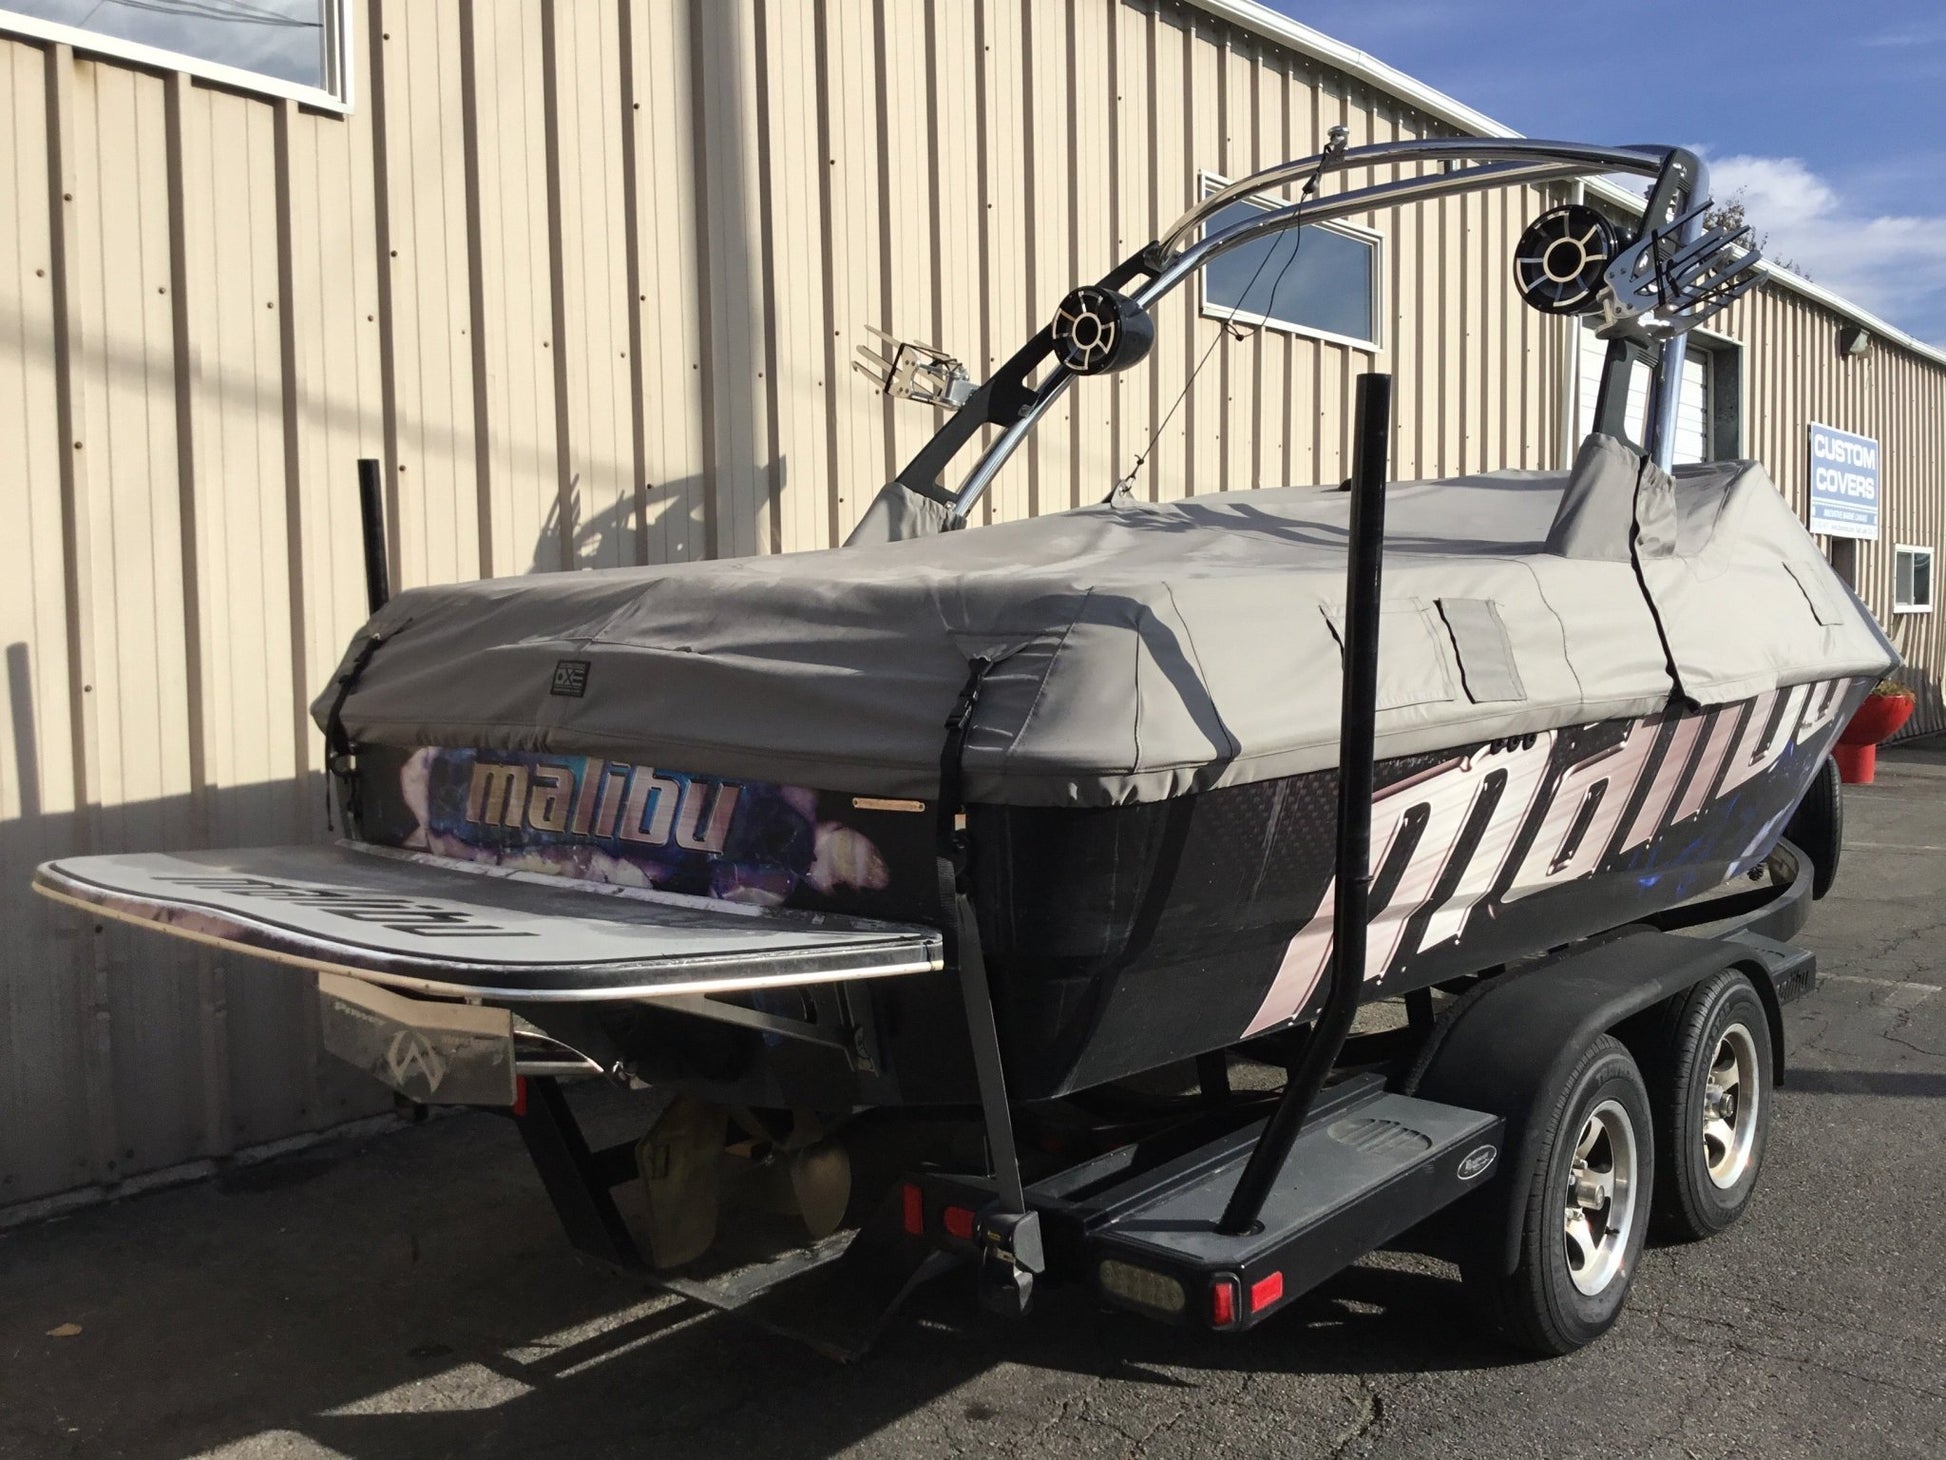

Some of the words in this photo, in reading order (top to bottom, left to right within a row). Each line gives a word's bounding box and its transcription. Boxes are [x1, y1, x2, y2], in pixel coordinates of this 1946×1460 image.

[1814, 434, 1876, 470] CUSTOM
[1816, 467, 1875, 500] COVERS
[465, 756, 743, 855] malibu
[150, 876, 541, 937] malibu
